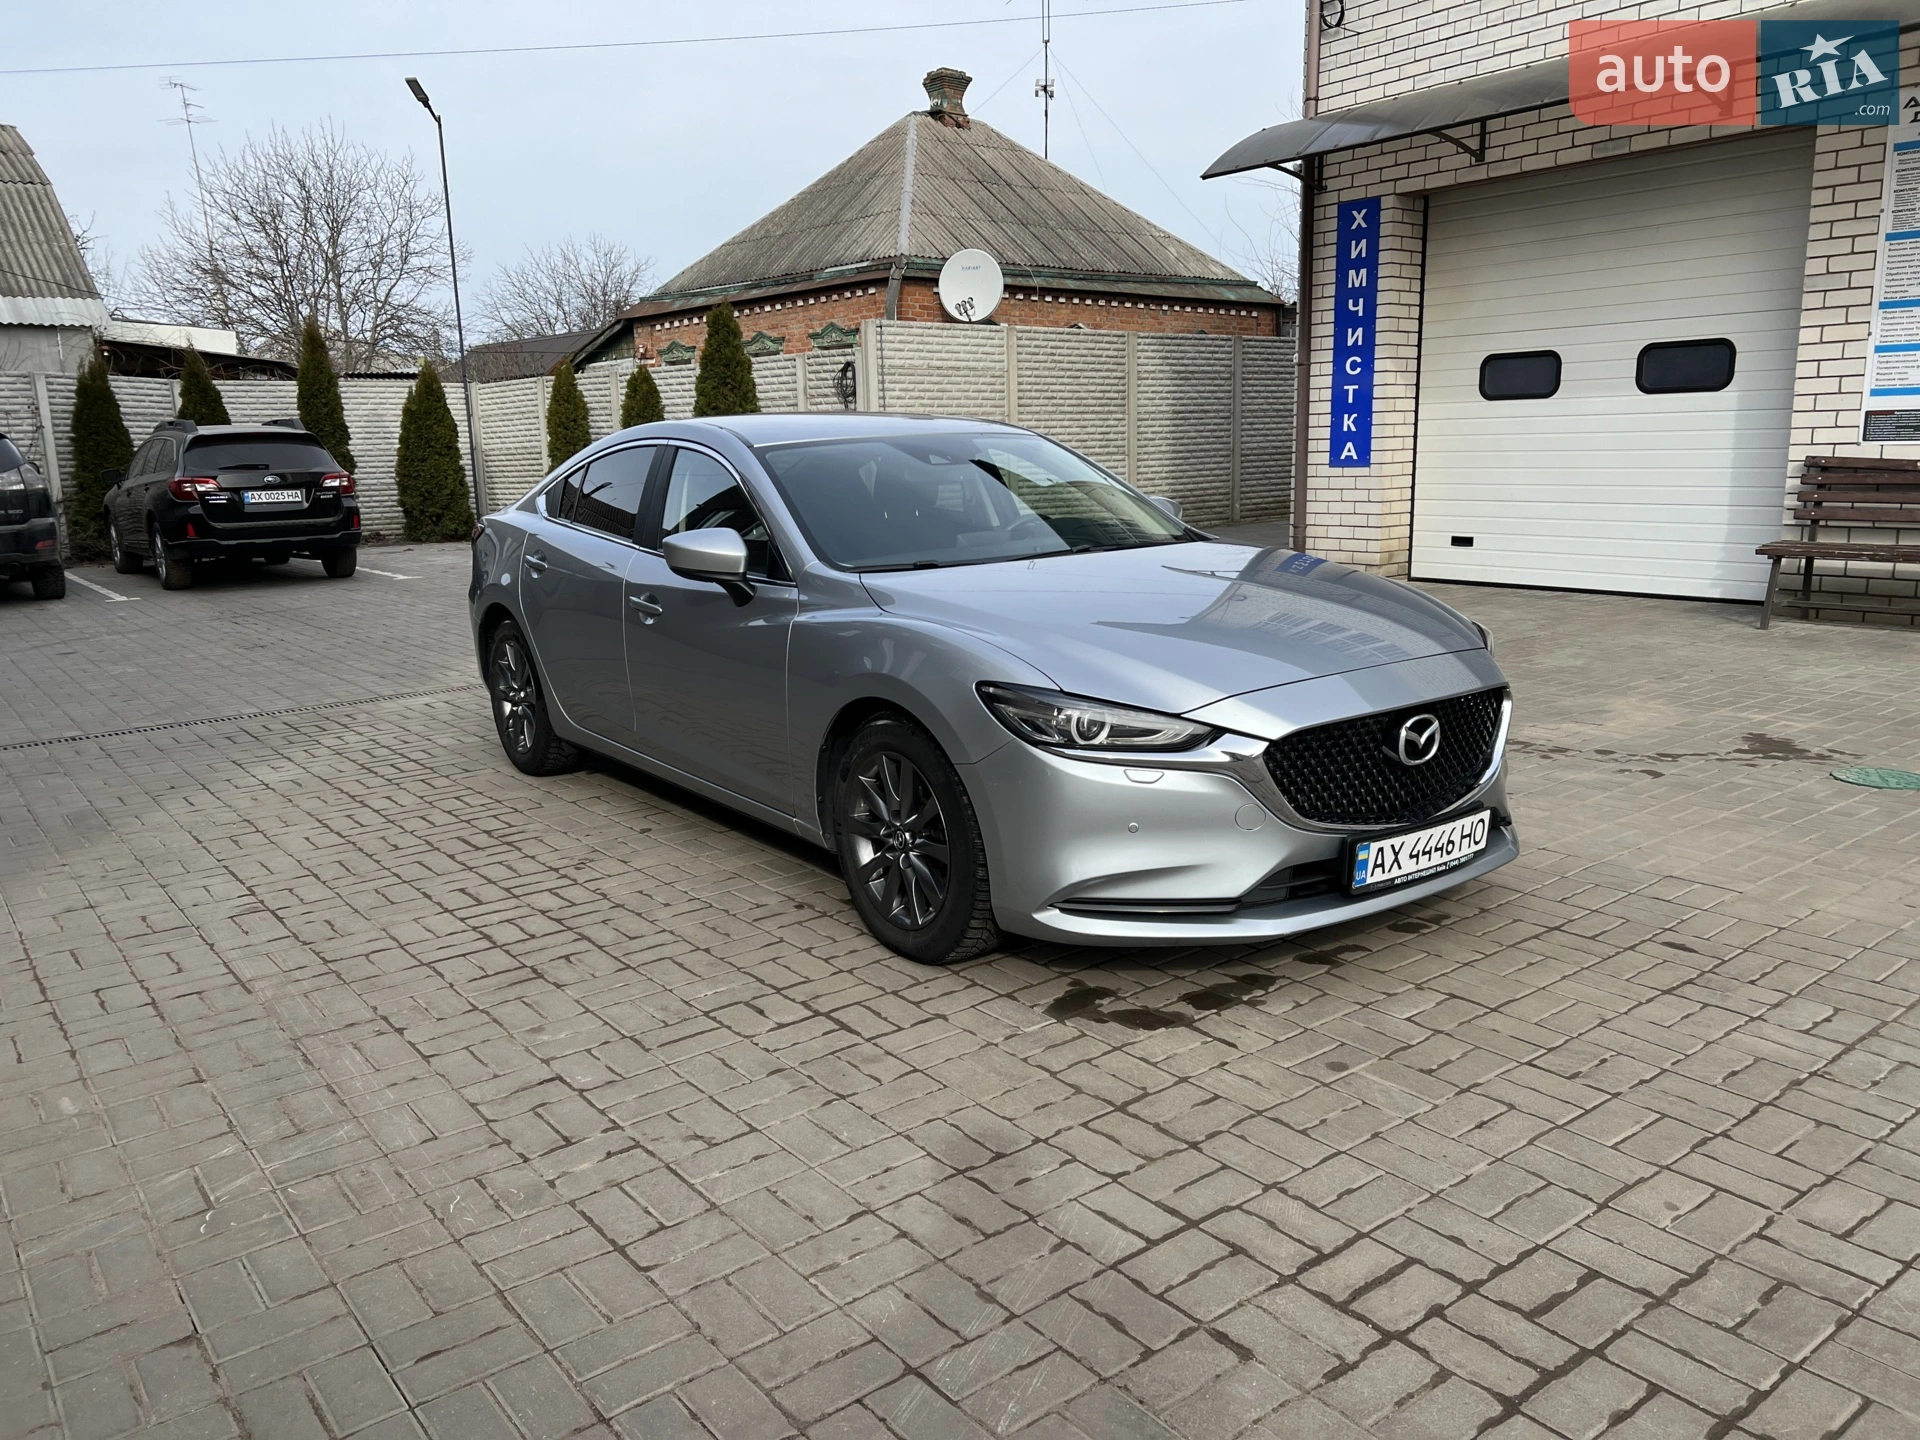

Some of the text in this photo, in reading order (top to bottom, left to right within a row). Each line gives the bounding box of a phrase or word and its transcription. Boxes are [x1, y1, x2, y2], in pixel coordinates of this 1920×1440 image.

[1340, 208, 1368, 460] ХИМЧИСТКА
[250, 491, 300, 501] AX 0025 HA
[1370, 817, 1486, 878] AX 4446 HO
[1355, 869, 1367, 881] UA
